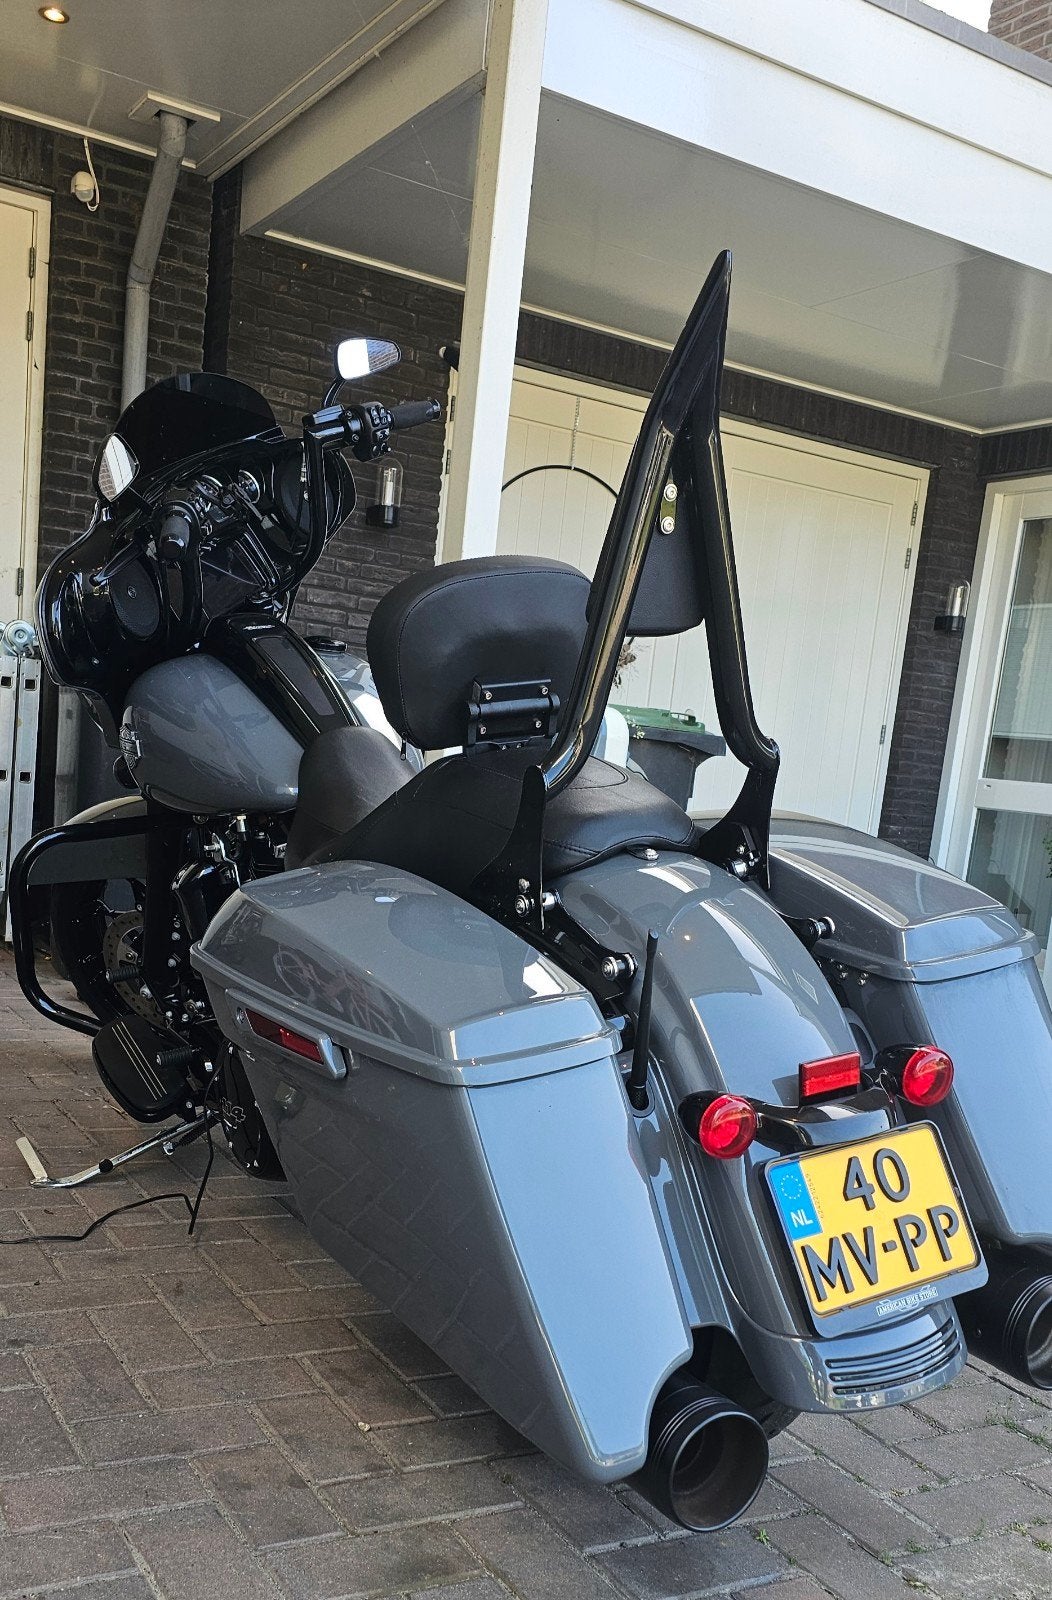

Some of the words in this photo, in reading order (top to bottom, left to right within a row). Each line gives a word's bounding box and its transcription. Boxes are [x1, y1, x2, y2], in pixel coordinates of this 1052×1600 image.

[843, 1148, 911, 1211] 40
[790, 1209, 814, 1228] NL
[801, 1205, 960, 1303] MV-PP
[878, 1298, 906, 1314] AMERICAN
[907, 1293, 919, 1306] BIKE
[920, 1288, 937, 1301] STORE
